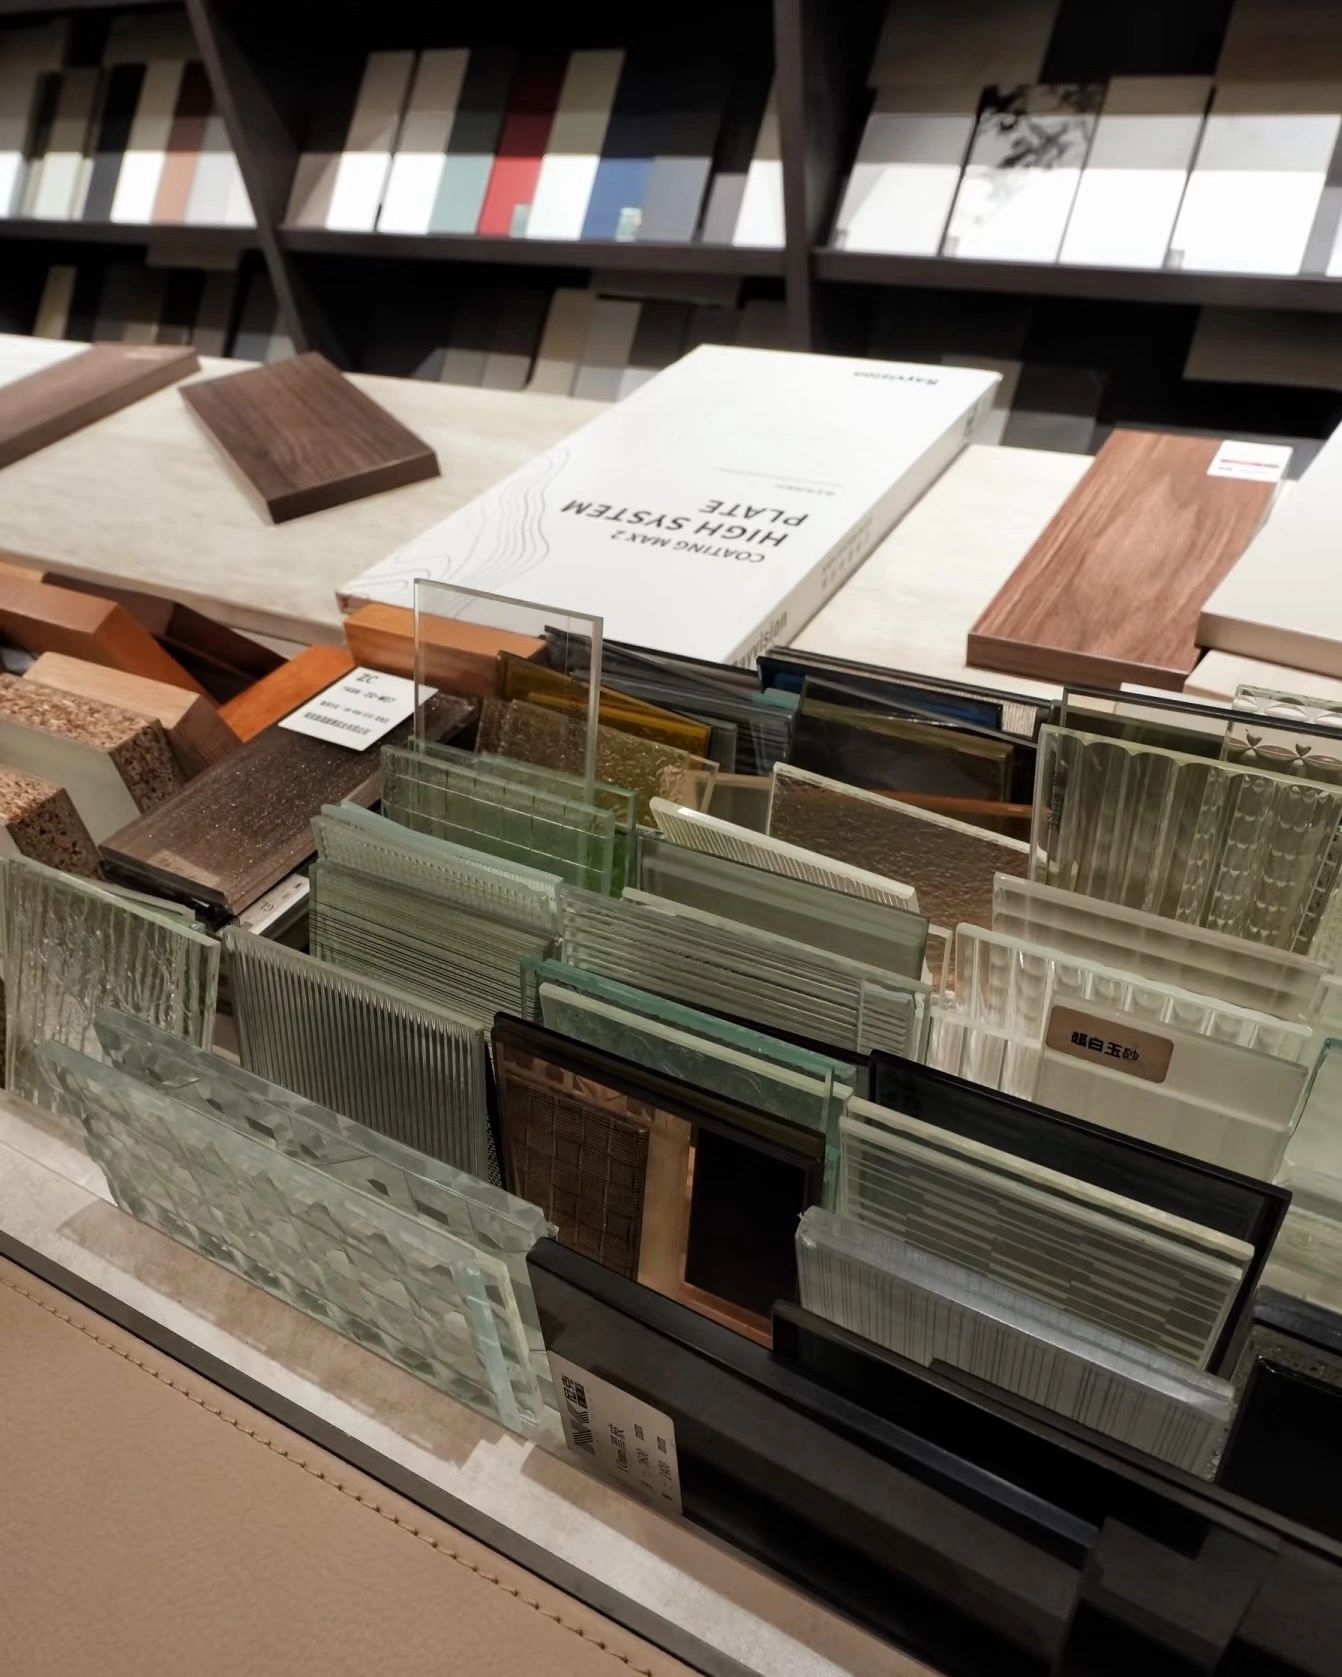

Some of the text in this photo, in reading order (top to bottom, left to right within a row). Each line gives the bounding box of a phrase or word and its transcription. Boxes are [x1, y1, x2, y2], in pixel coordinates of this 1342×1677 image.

[560, 499, 789, 547] HIGH SYSTEM
[699, 499, 809, 527] PLATE
[625, 532, 671, 547] MAX
[673, 539, 766, 563] COATING
